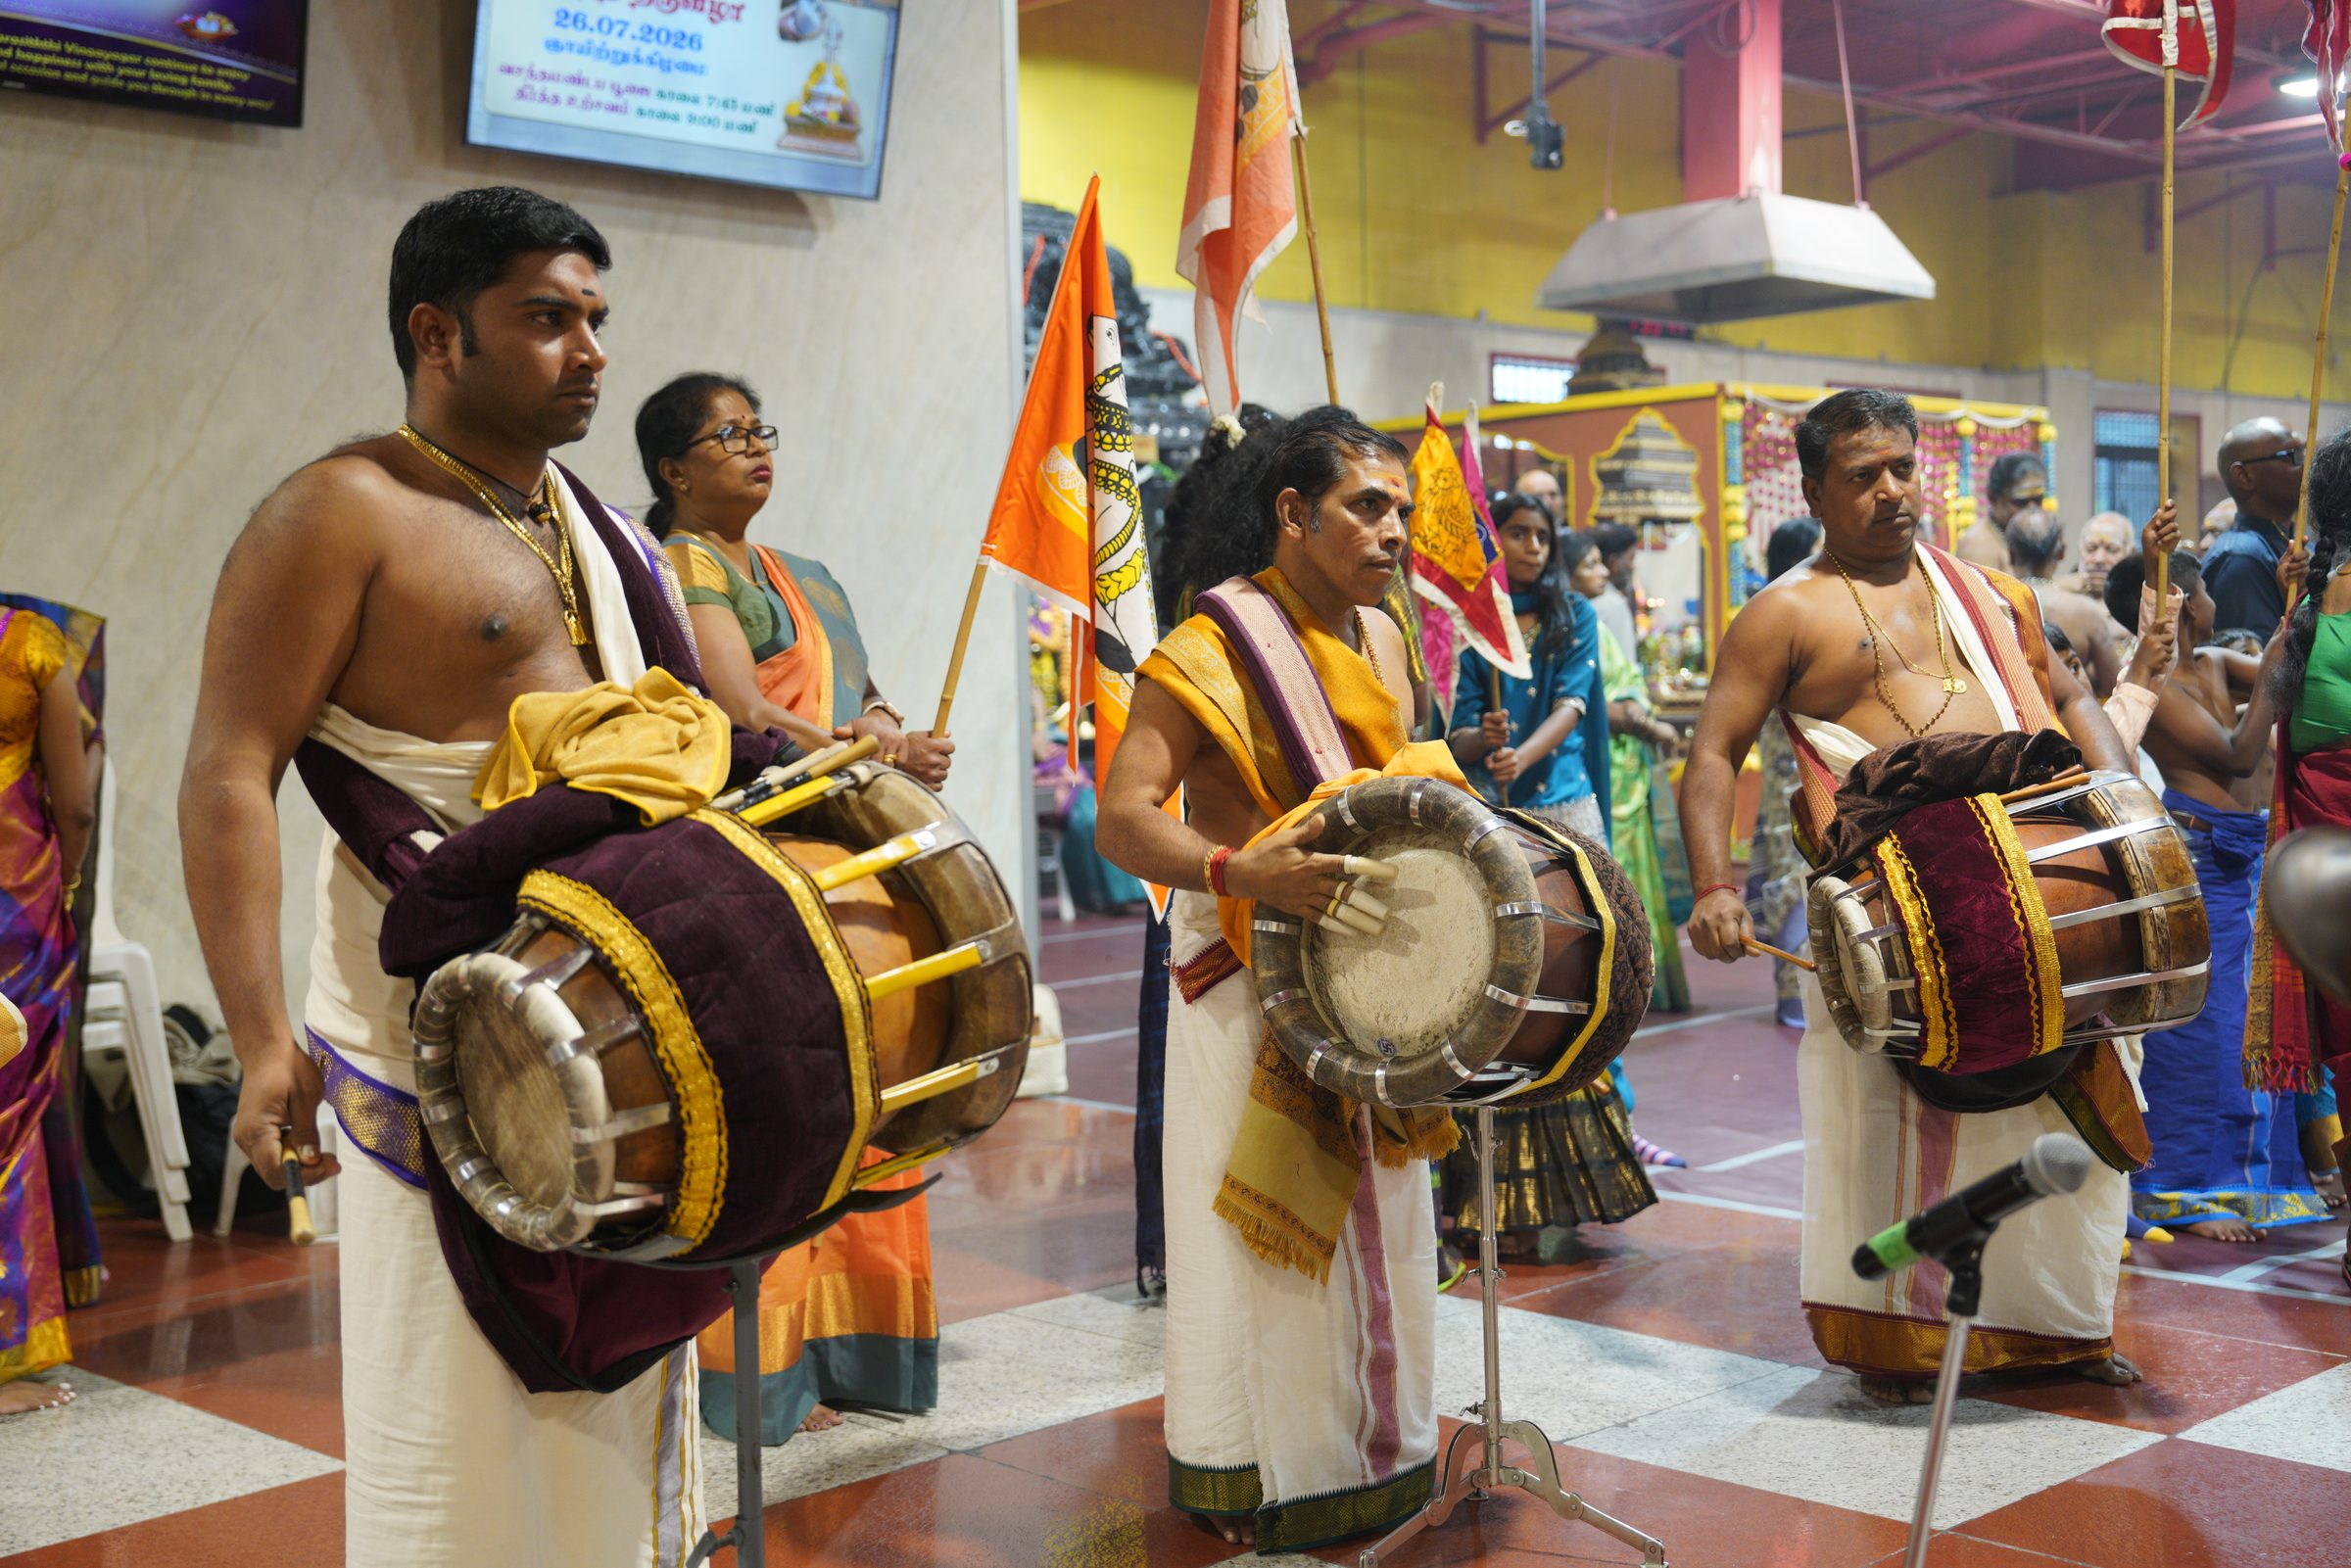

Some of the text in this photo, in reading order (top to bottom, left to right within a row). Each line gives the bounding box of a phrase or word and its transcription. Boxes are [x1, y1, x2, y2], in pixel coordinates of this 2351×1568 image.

[554, 9, 703, 51] 26.07.2026
[145, 57, 197, 71] continue
[656, 89, 700, 104] காலை
[743, 103, 775, 118] மணி
[636, 107, 680, 121] காலை
[724, 121, 756, 134] மணி
